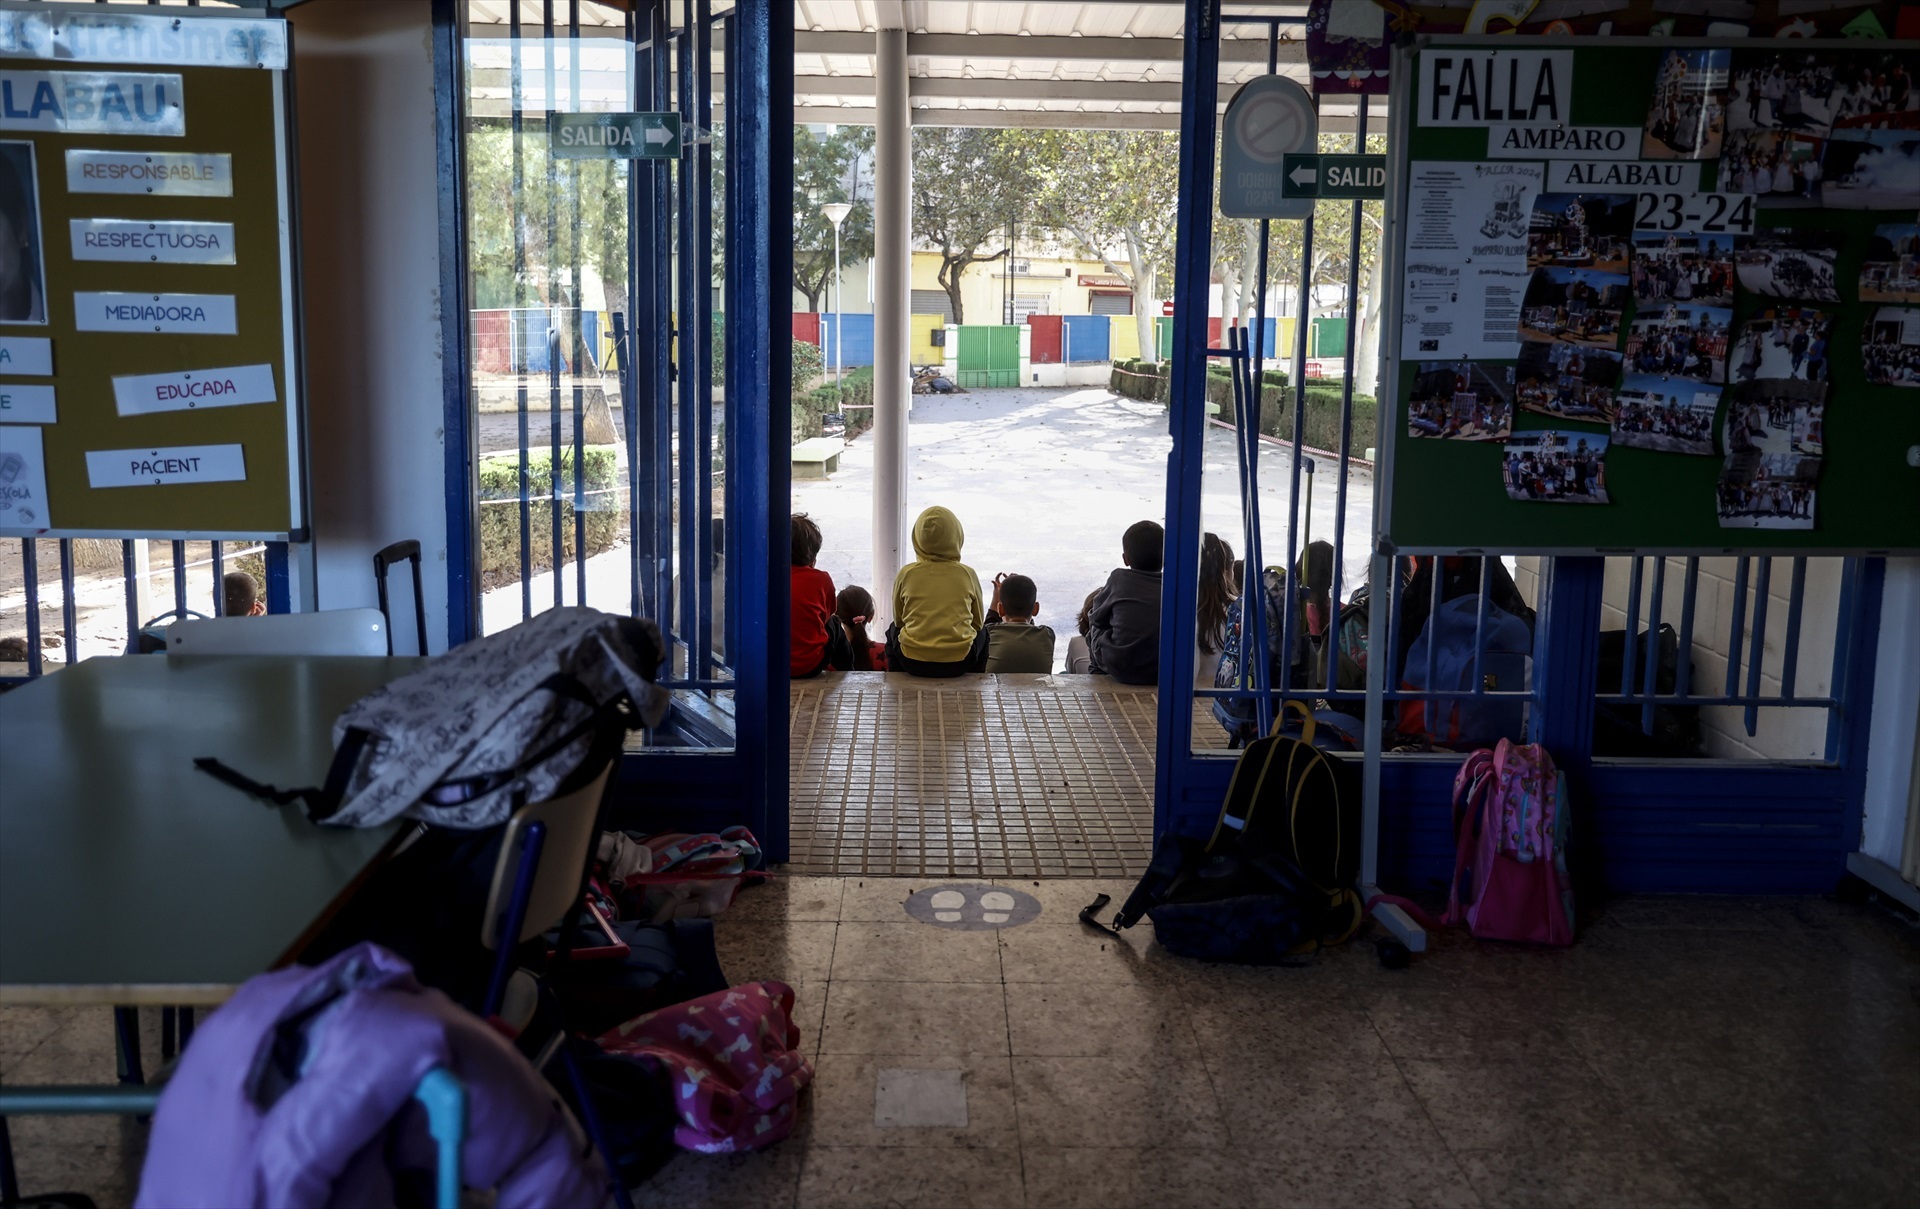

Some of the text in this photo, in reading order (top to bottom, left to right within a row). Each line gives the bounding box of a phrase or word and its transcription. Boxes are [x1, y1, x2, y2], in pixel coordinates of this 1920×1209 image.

[1432, 58, 1558, 120] FALLA
[0, 80, 166, 123] LABAU
[560, 126, 635, 146] SALIDA
[1502, 128, 1626, 150] AMPARO
[83, 163, 215, 181] RESPONSABLE
[1327, 167, 1386, 187] SALID
[1565, 163, 1684, 186] ALABAU
[1635, 193, 1754, 232] 23-24
[85, 232, 220, 249] RESPECTUOSA
[105, 305, 206, 322] MEDIADORA
[156, 380, 237, 400] EDUCADA
[131, 458, 201, 475] PACIENT
